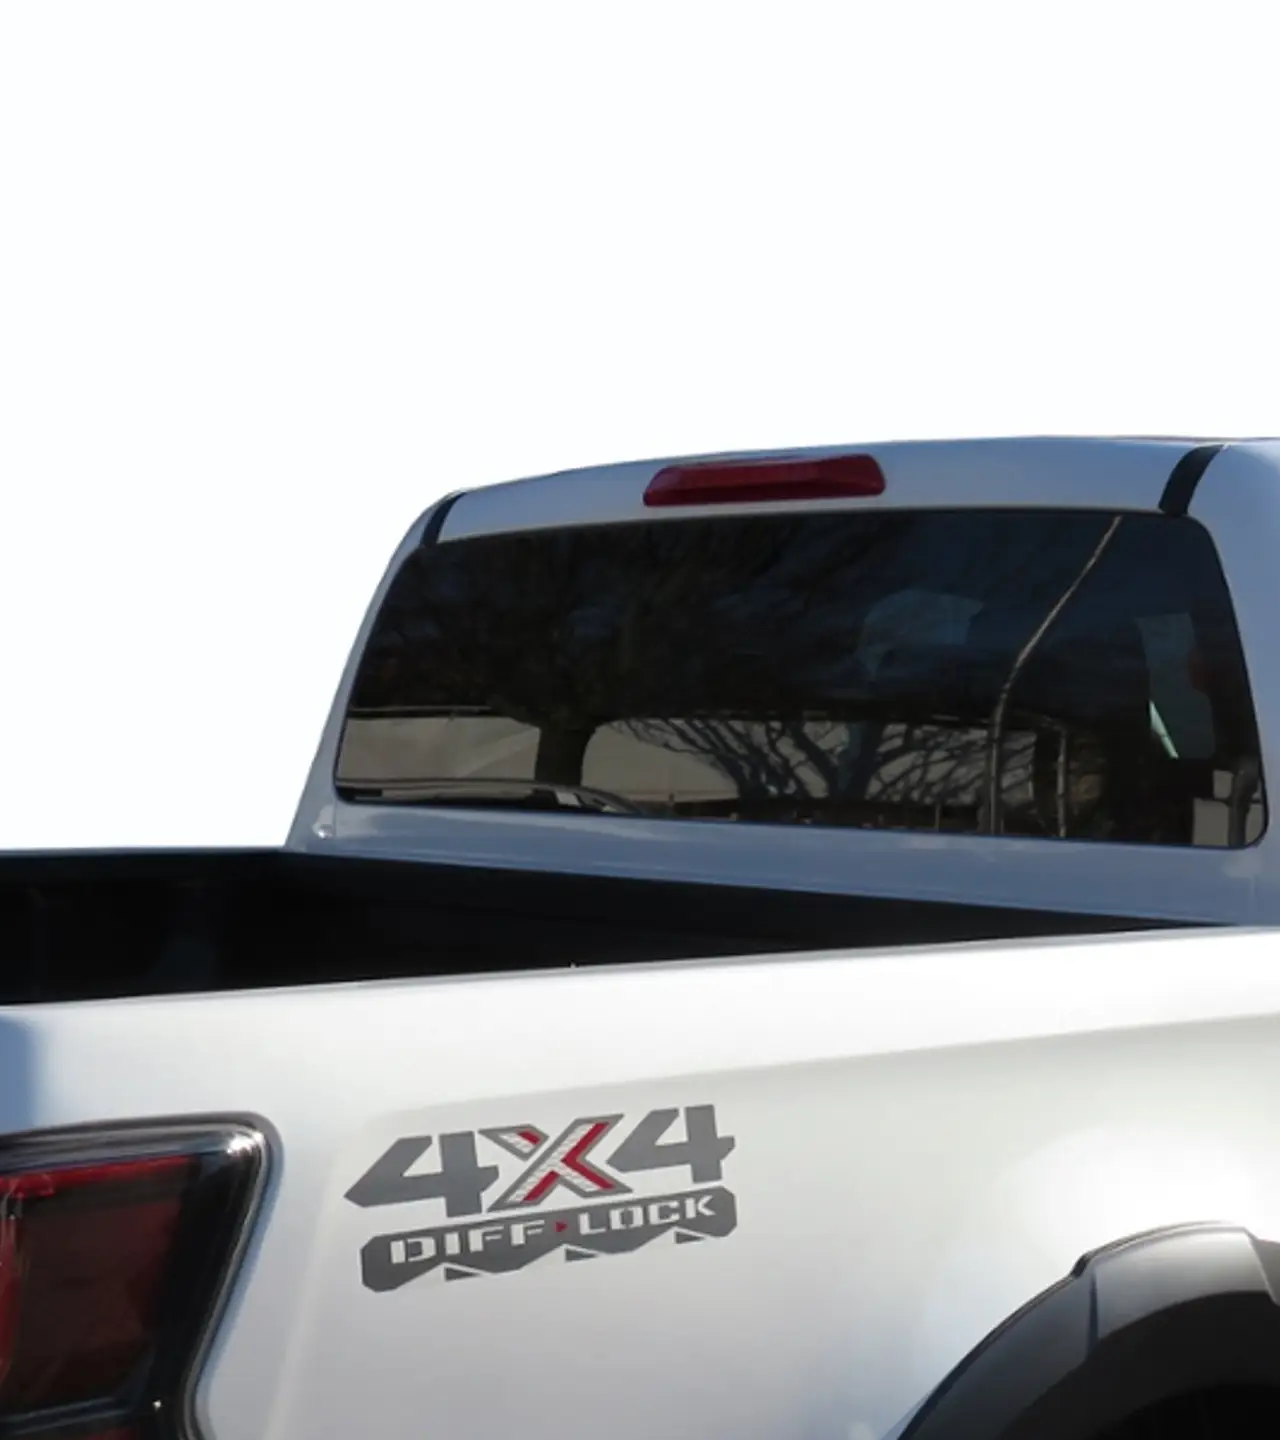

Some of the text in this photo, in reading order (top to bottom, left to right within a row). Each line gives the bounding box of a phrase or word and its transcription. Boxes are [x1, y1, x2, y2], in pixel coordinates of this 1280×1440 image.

[343, 1103, 737, 1219] 4X4
[388, 1194, 717, 1265] DIFF LOCK
